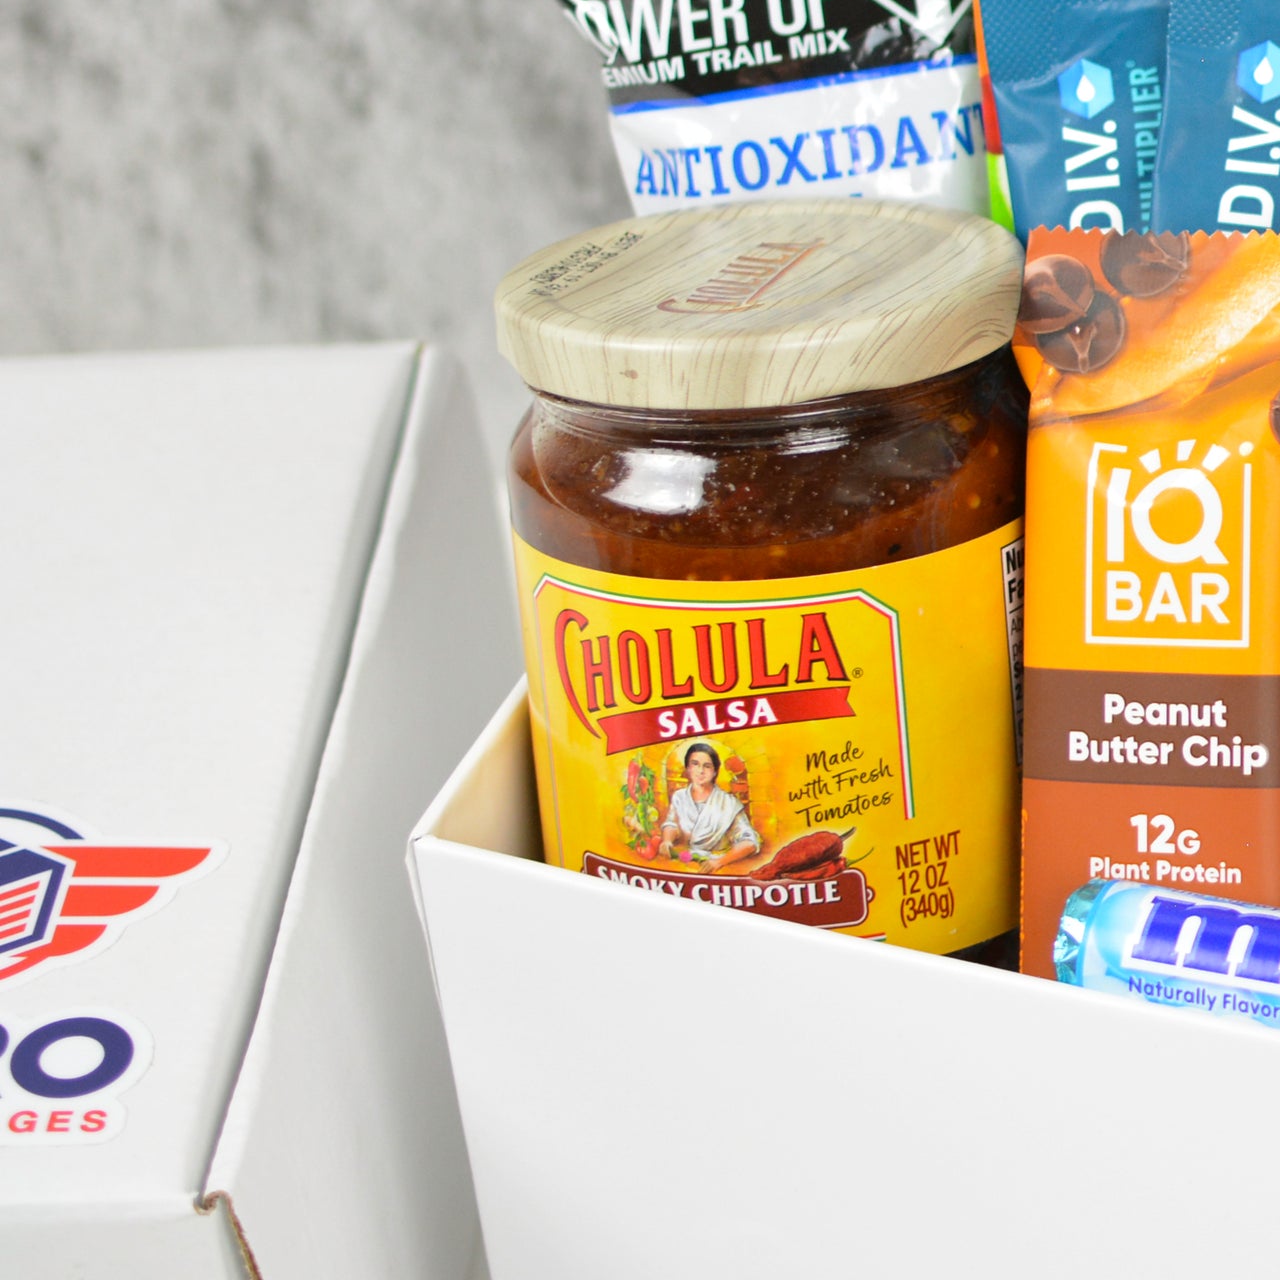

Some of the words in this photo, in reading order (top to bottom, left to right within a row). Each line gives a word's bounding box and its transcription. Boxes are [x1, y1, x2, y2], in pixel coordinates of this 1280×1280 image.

[691, 39, 783, 77] TRAIL
[787, 26, 851, 61] MIX
[1105, 465, 1230, 566] IQ
[1104, 571, 1231, 625] BAR
[553, 608, 852, 740] CHOLULA
[657, 699, 778, 739] SALSA
[1103, 693, 1227, 728] Peanut
[806, 741, 865, 774] Made
[1067, 731, 1175, 765] Butter
[1181, 734, 1269, 776] Chip
[789, 776, 834, 803] with
[834, 759, 895, 794] Fresh
[796, 791, 894, 828] Tomatoes
[895, 842, 931, 870] NET
[932, 830, 962, 857] WT
[1130, 813, 1201, 855] 12G
[898, 871, 922, 894] 12
[924, 865, 949, 889] OZ
[1089, 856, 1152, 883] Plant
[1155, 858, 1242, 886] Protein
[691, 879, 842, 910] CHIPOTLE
[900, 888, 957, 928] (340g)
[1127, 975, 1217, 1013] Naturally
